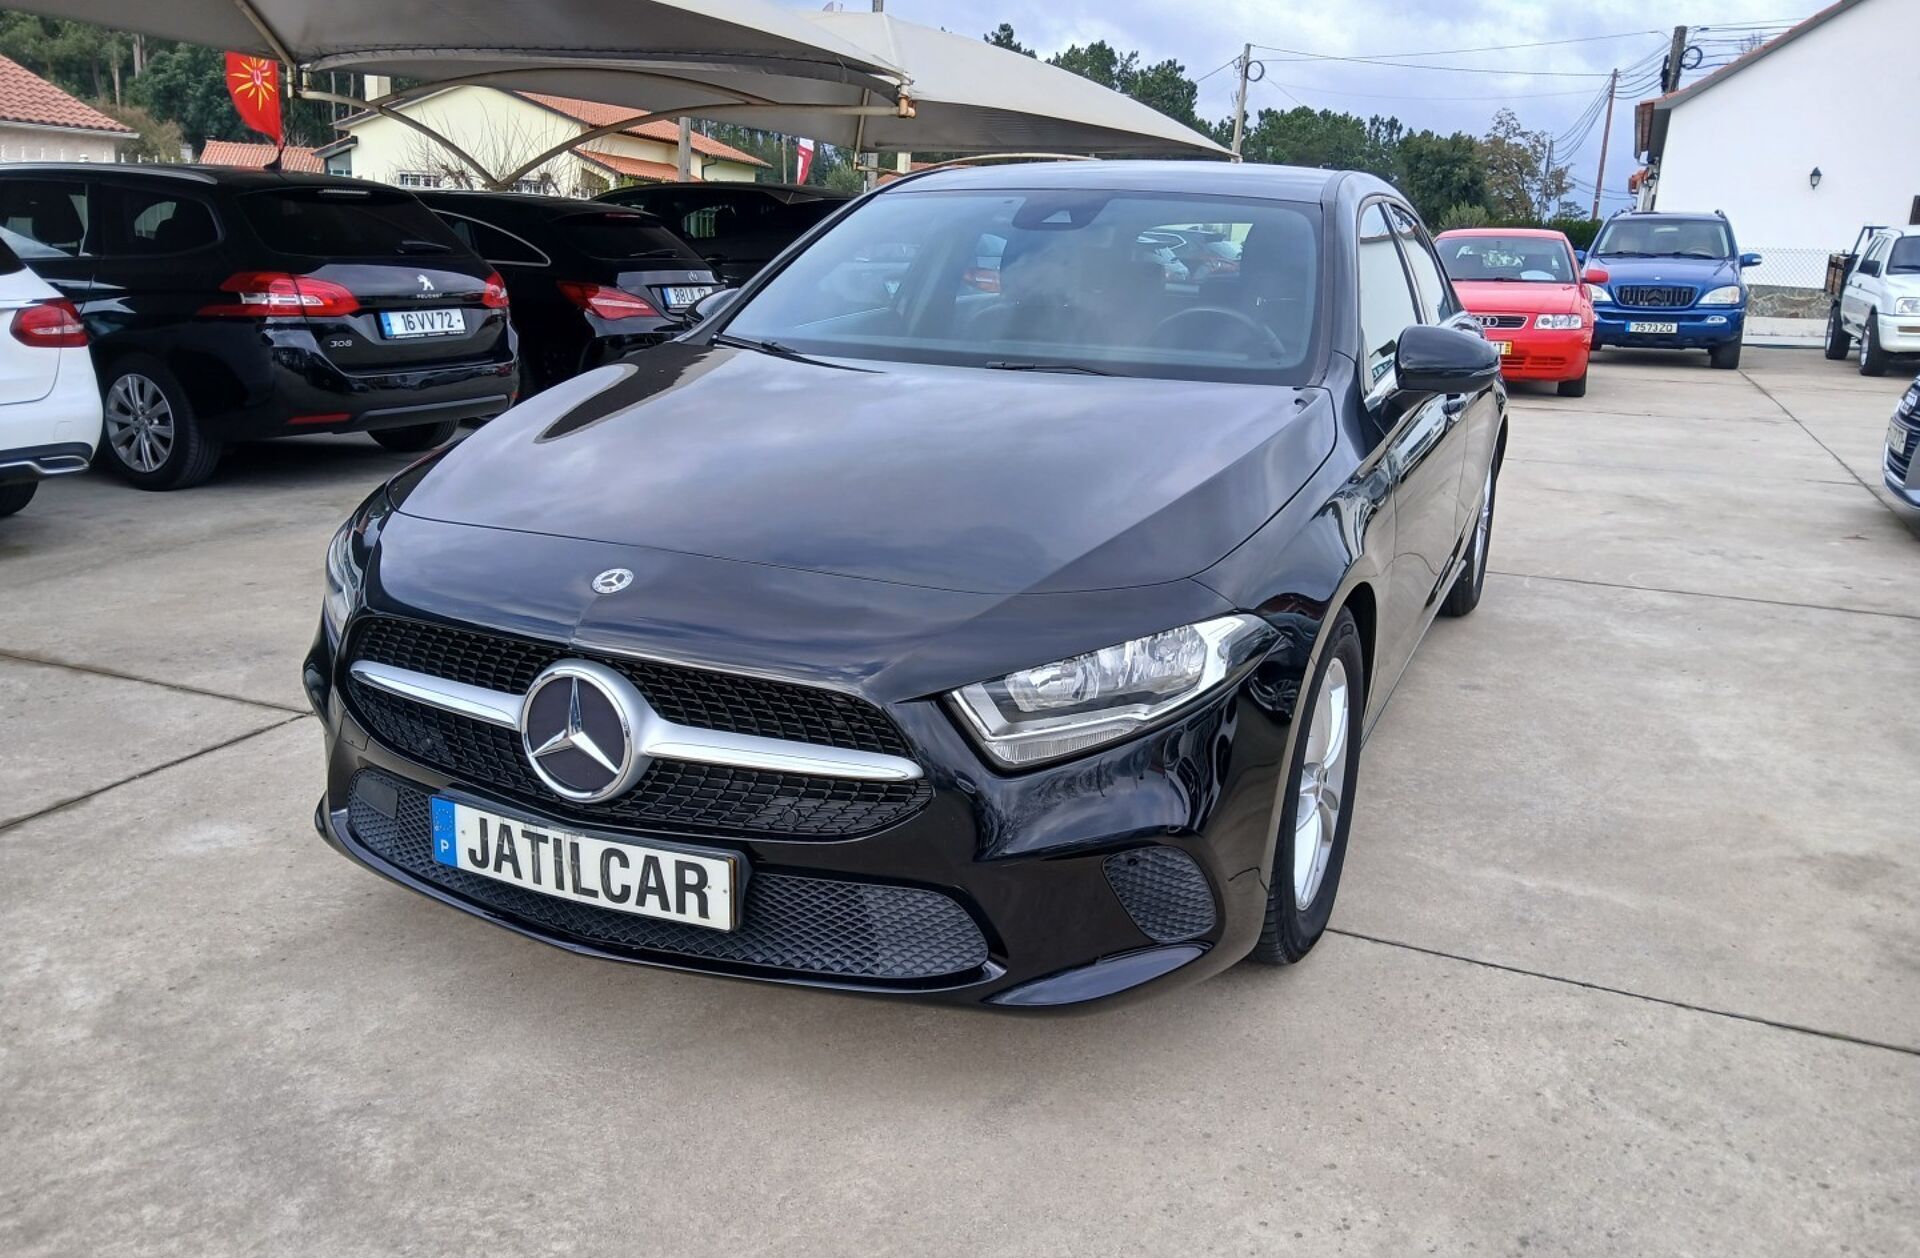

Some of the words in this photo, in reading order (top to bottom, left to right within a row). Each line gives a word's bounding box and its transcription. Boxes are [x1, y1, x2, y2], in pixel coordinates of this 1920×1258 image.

[401, 311, 454, 331] 16VV72
[330, 340, 352, 348] 308
[440, 839, 449, 853] P
[467, 817, 711, 920] JATILCAR
